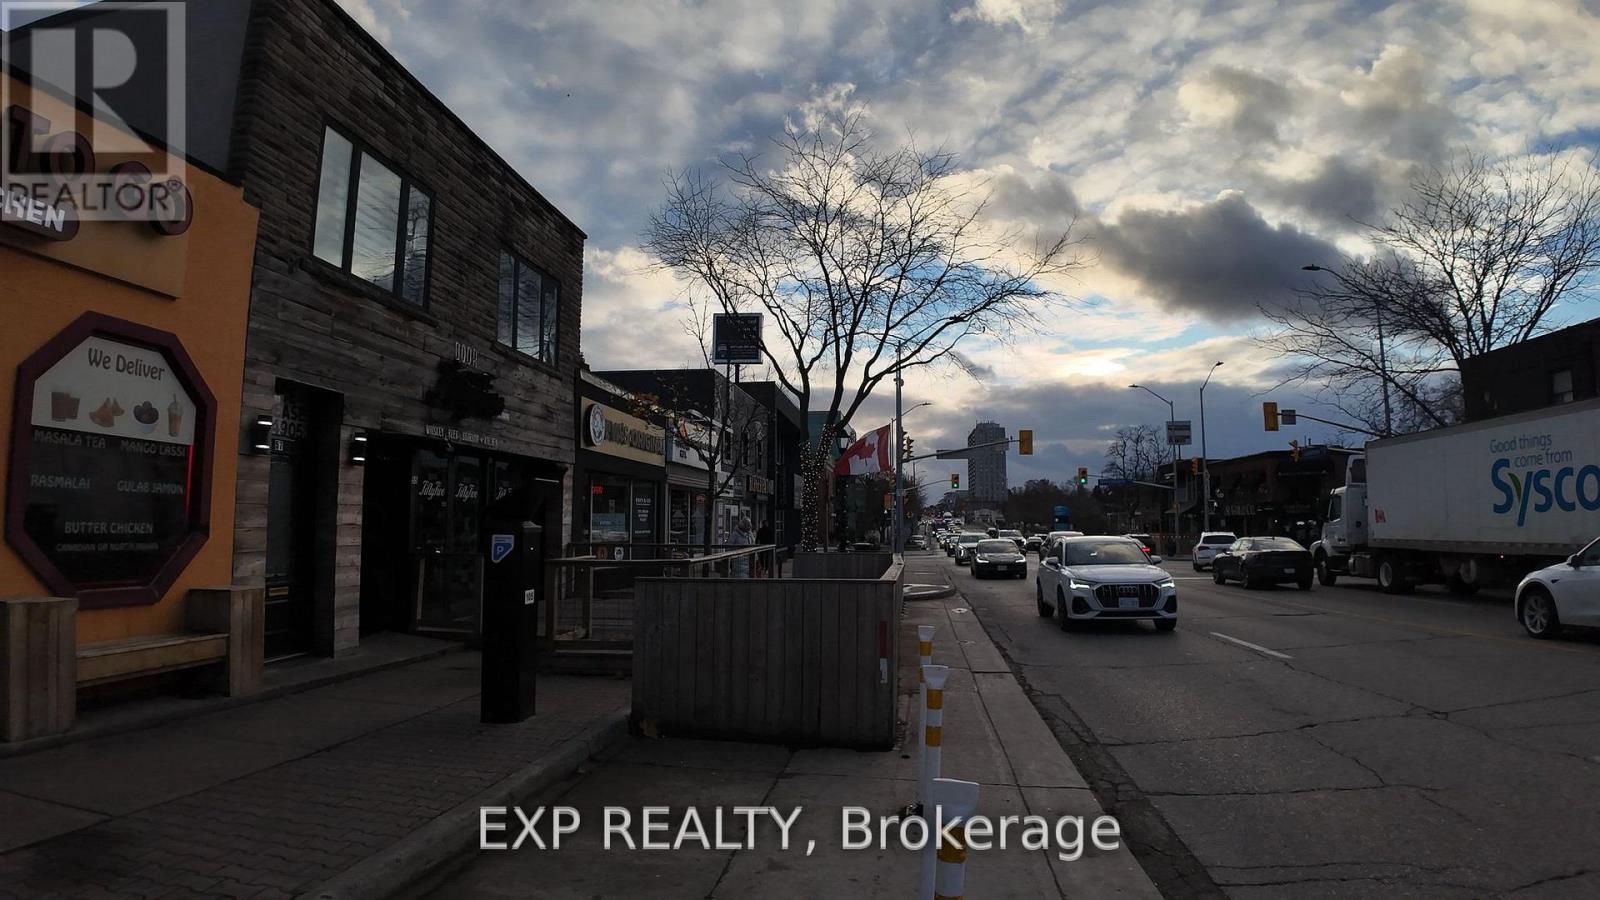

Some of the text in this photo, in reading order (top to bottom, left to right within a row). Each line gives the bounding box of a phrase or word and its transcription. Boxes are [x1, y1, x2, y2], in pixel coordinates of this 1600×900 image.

[0, 188, 66, 233] HEN
[88, 347, 166, 381] We Deliver
[33, 429, 107, 450] MASALA TEA
[121, 440, 186, 457] MANGO LASSI
[1490, 434, 1552, 453] Good things
[1514, 448, 1572, 468] come from
[31, 474, 90, 489] RASMALAI
[117, 480, 150, 494] GULAB
[65, 521, 153, 535] BUTTER CHICKEN
